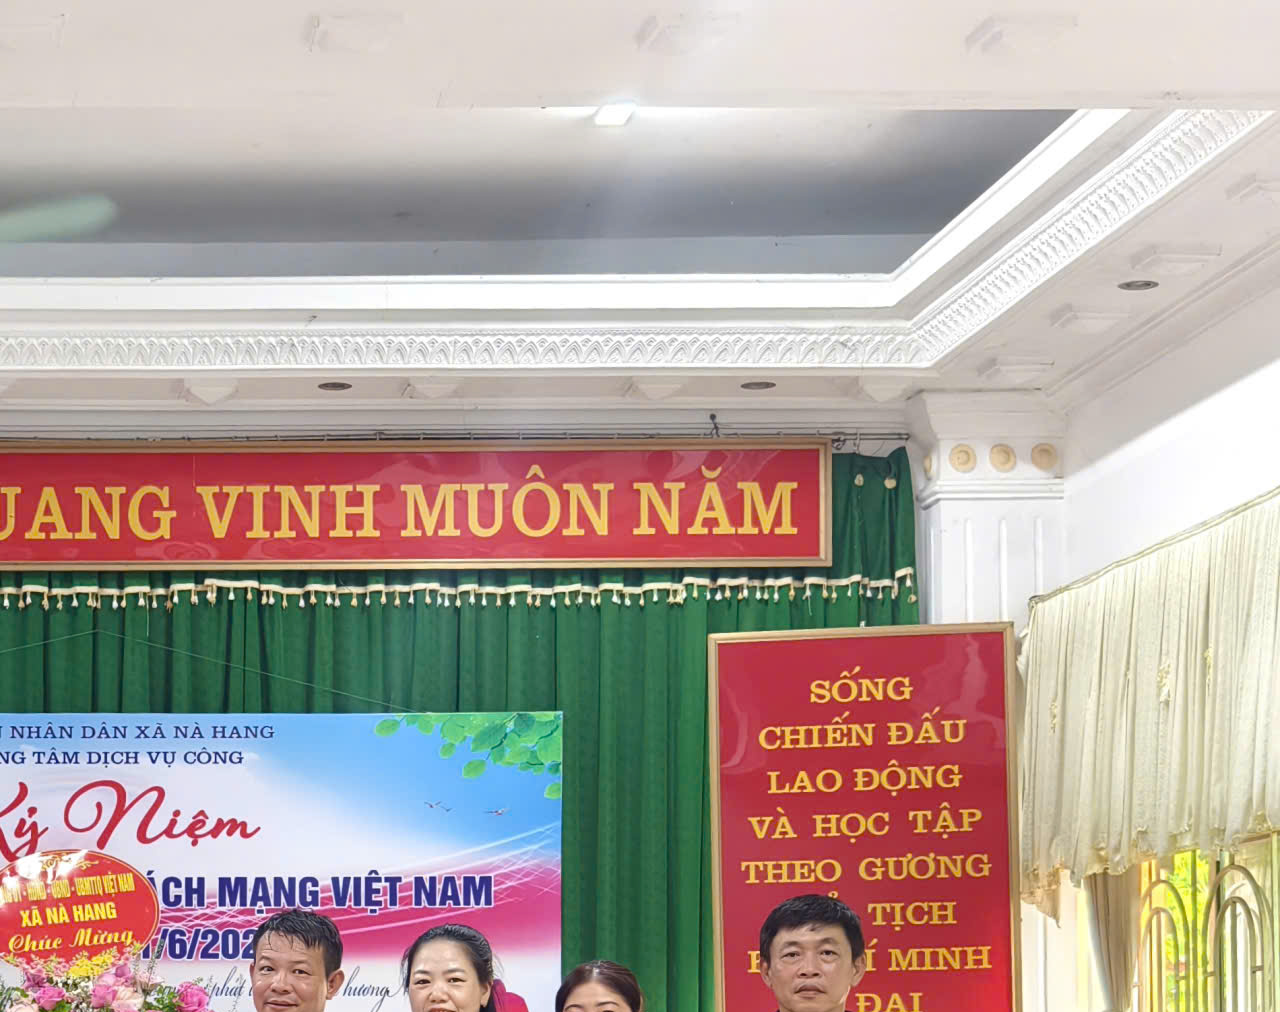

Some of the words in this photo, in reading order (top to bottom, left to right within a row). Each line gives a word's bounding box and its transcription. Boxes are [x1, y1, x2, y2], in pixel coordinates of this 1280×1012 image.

[196, 484, 381, 539] VINH
[400, 464, 615, 539] MUÔN
[631, 464, 799, 536] NĂM
[810, 666, 913, 704] SỐNG
[10, 721, 75, 739] NHÂN
[80, 721, 129, 739] DÂN
[134, 722, 167, 739] XÃ
[173, 721, 205, 739] NÀ
[211, 725, 276, 739] HANG
[758, 711, 876, 750] CHIẾN
[887, 707, 967, 745] ĐẤU
[32, 746, 81, 765] TÂM
[86, 751, 140, 768] DỊCH
[146, 751, 177, 768] VỤ
[183, 746, 244, 765] CÔNG
[767, 769, 843, 794] LAO
[854, 759, 963, 796] ĐỘNG
[63, 780, 260, 849] Niệm
[747, 807, 798, 839] VÀ
[812, 812, 889, 843] HỌC
[908, 802, 982, 839] TẬP
[117, 873, 134, 892] NAM
[741, 859, 842, 884] THEO
[858, 852, 992, 881] GƯƠNG
[218, 876, 319, 914] MẠNG
[331, 869, 402, 914] VIỆT
[414, 875, 492, 907] NAM
[21, 906, 42, 927] XÃ
[45, 903, 70, 924] NÀ
[72, 901, 118, 922] HANG
[867, 902, 957, 931] TỊCH
[8, 932, 63, 954] Chúc
[70, 927, 133, 948] Mừng
[888, 946, 993, 971] MINH
